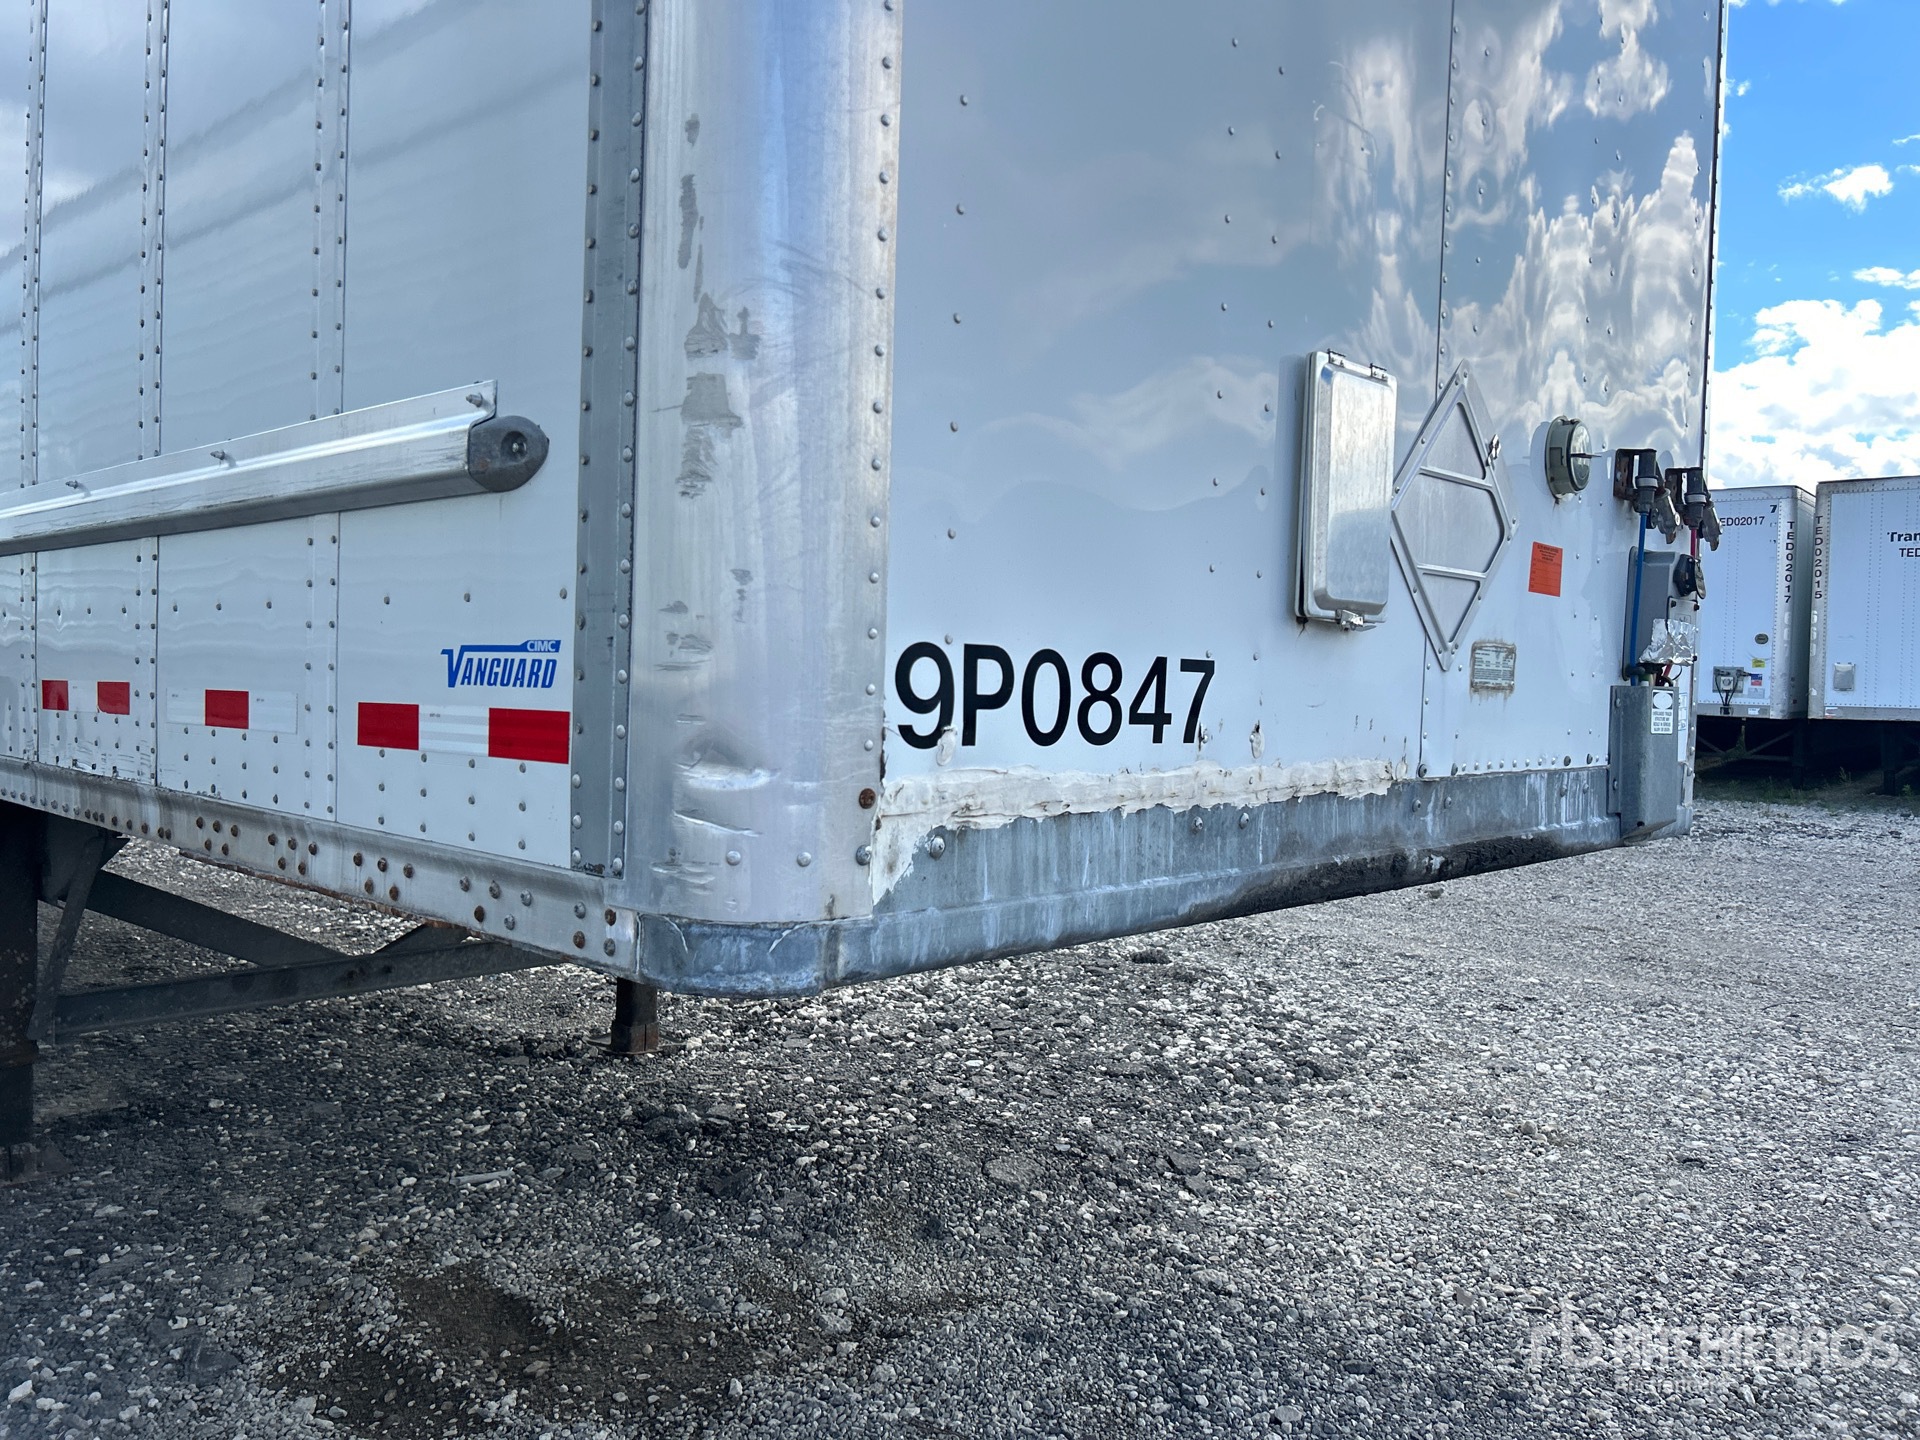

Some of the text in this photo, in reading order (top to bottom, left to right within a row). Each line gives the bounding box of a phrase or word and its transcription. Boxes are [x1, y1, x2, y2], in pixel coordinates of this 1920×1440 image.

[1719, 516, 1765, 527] ED02017
[1783, 521, 1795, 603] TED02017
[1814, 515, 1823, 599] TED02015
[441, 645, 557, 688] VANGUARD
[527, 640, 556, 652] CIMC
[895, 641, 1215, 749] 9P0847
